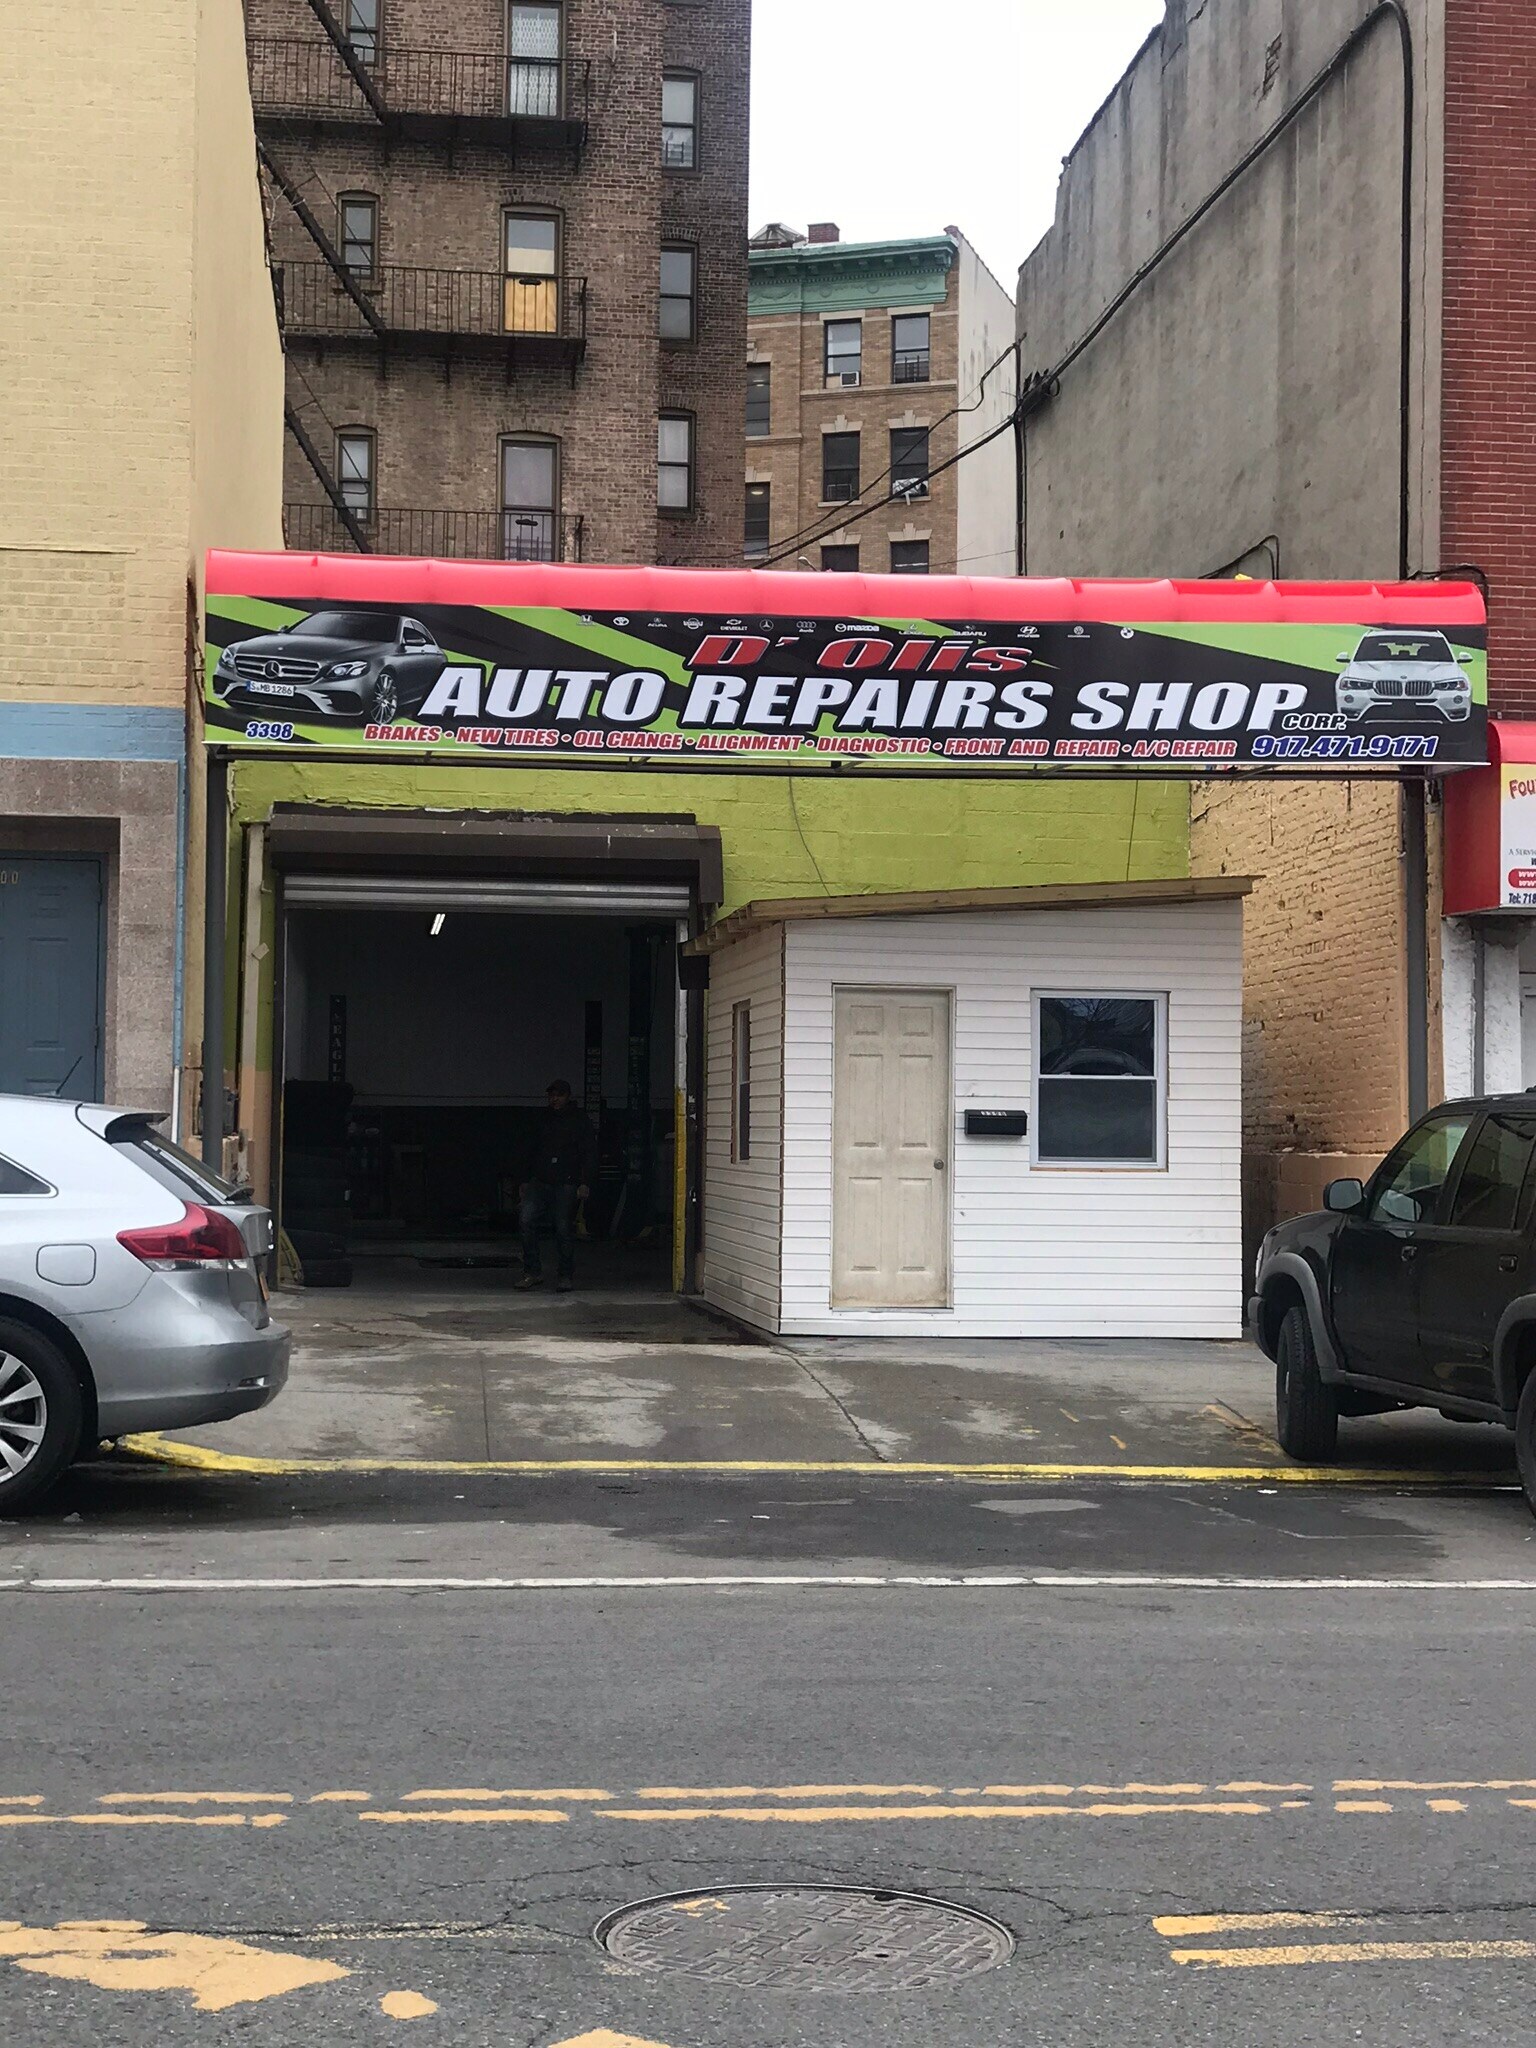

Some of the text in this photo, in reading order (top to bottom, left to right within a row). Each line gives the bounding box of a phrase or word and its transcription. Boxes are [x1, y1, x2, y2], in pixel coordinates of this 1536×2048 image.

[416, 667, 666, 722] AUTO
[681, 674, 1054, 730] REPAIRS
[1070, 681, 1308, 732] SHOP
[246, 721, 294, 740] 3398
[364, 724, 1238, 758] BRAKES NEW TIRES OIL CHANGE ALIGNMENT DIAGNOSTIC FRONT AND REPAIR A/C REPAIR
[1251, 734, 1439, 758] 917.471.9171
[1508, 778, 1536, 800] FOU
